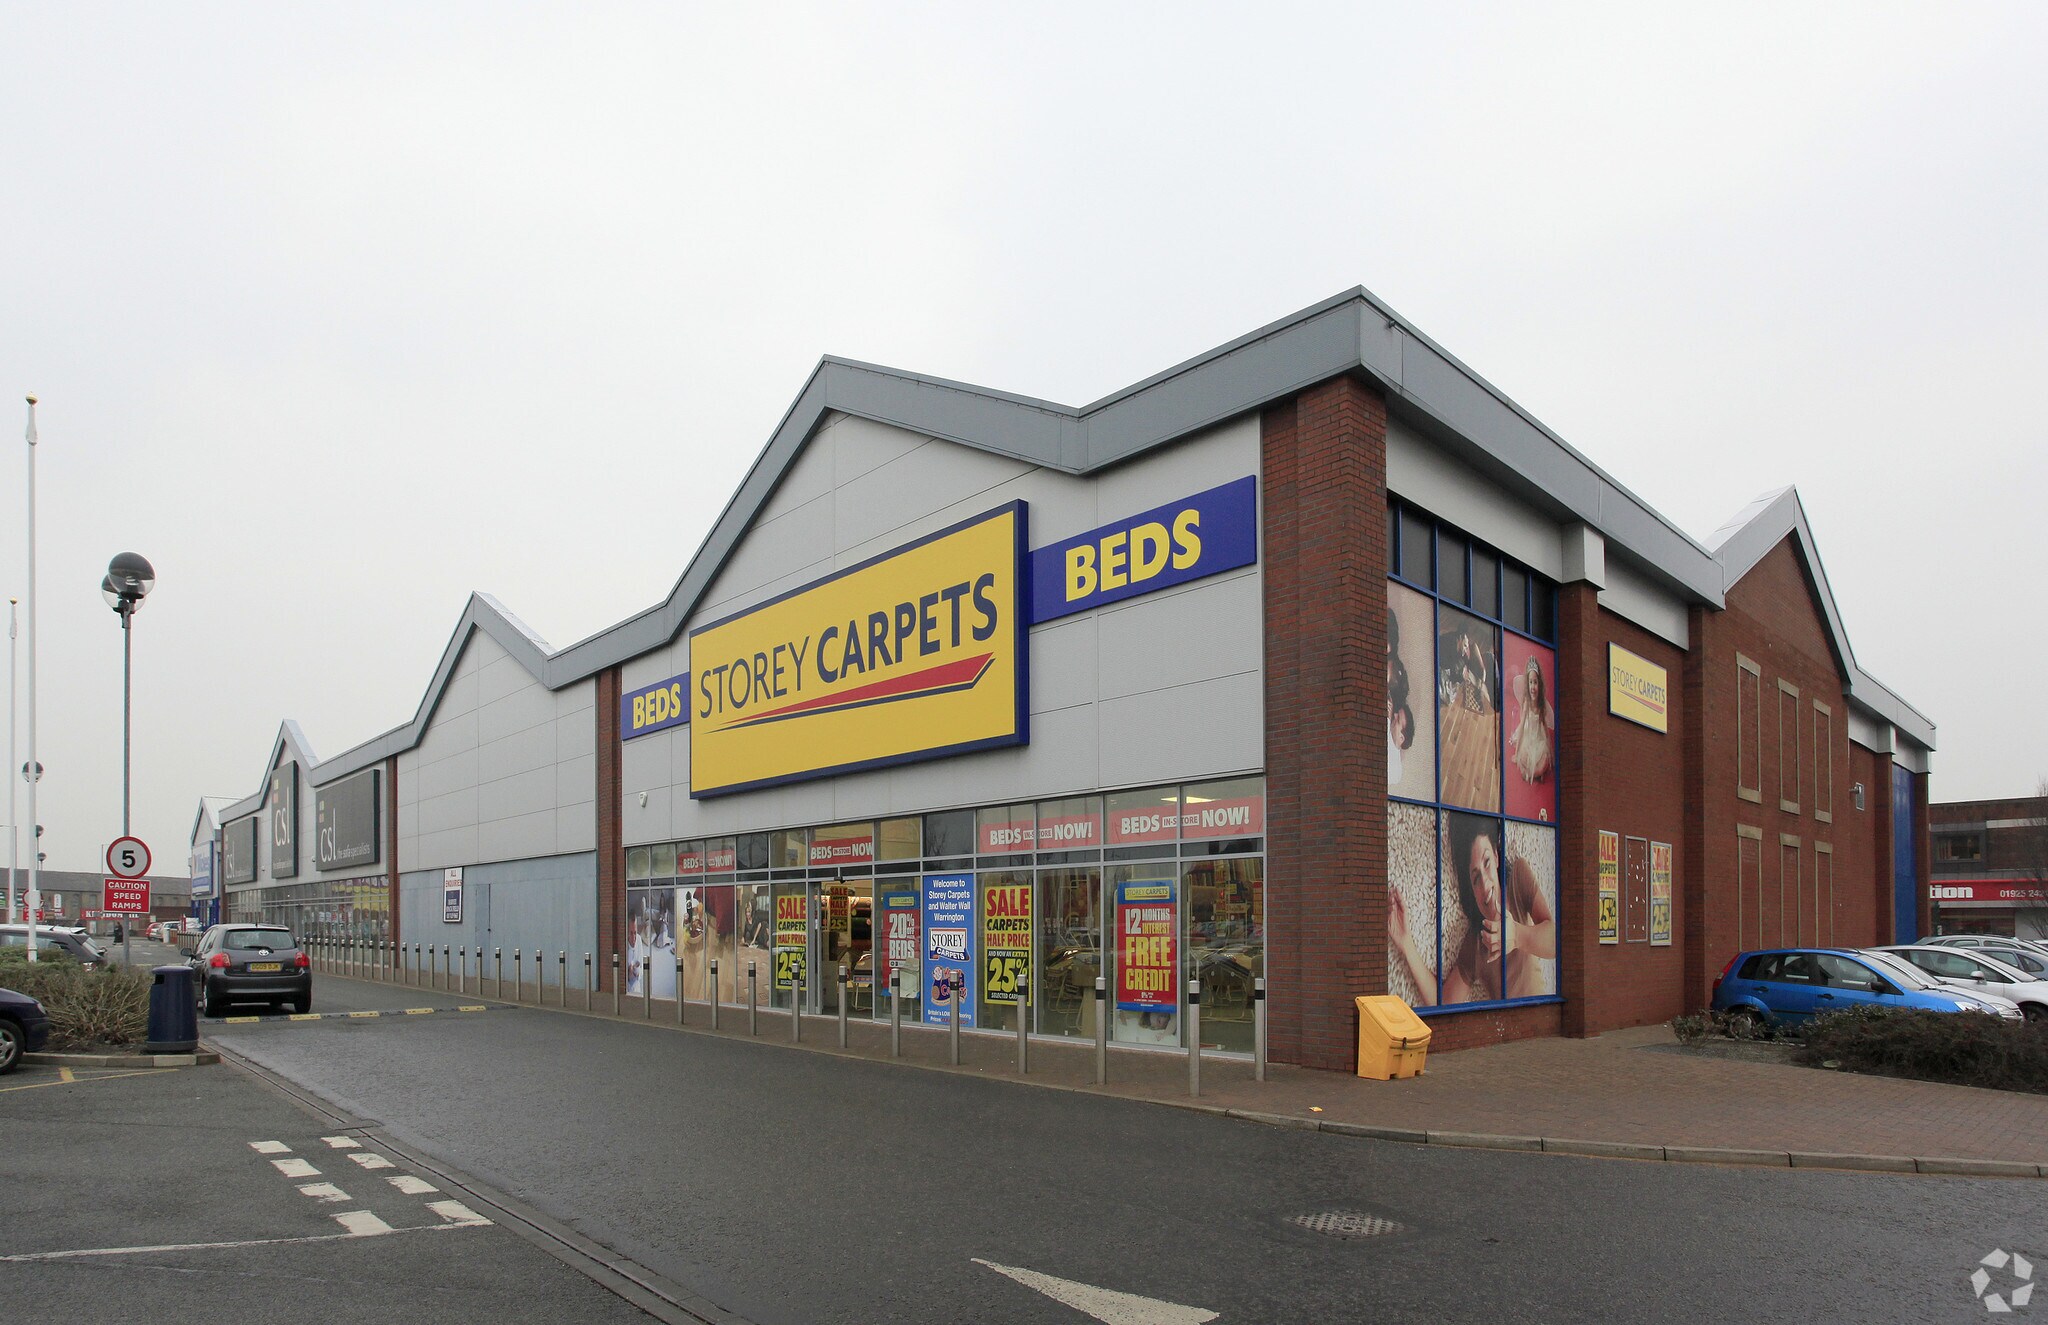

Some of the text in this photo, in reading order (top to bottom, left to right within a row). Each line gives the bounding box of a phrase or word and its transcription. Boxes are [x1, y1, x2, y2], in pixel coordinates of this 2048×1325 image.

[1065, 509, 1202, 603] BEDS
[700, 573, 998, 718] STOREY CARPETS
[1612, 666, 1666, 704] STOREY CARPETS
[632, 682, 681, 730] BEDS
[275, 787, 290, 847] csl
[1121, 806, 1249, 834] BEDS IN-STORE NOW!
[321, 808, 336, 862] csl
[990, 821, 1092, 846] BEDS IN-SORE NOW!
[811, 846, 832, 860] BEDS
[1601, 836, 1616, 861] ALE
[122, 850, 136, 868] 5
[683, 857, 699, 869] BEDS
[108, 882, 147, 890] CAUTION
[831, 887, 848, 895] SALE
[933, 879, 966, 888] Welcome to
[113, 892, 141, 900] SPEED
[929, 890, 971, 900] Storey Carpets
[986, 889, 1029, 917] SALE
[112, 902, 142, 910] RAMPS
[778, 897, 806, 920] SALE
[831, 900, 848, 909] HALF
[928, 902, 939, 910] and
[958, 901, 971, 910] Wall
[778, 921, 806, 931] CARPETS
[889, 913, 914, 939] 20%
[934, 913, 965, 923] Warrington
[986, 918, 1029, 931] CARPETS
[1125, 908, 1170, 934] 12 MONTHS
[1142, 922, 1170, 934] INTEREST
[778, 932, 806, 944] HALF PRICE
[931, 934, 963, 947] STOREY
[987, 933, 1029, 947] HALF PRICE
[889, 940, 914, 959] BEDS
[936, 948, 965, 960] CARPETS
[1125, 936, 1171, 967] FREE
[988, 958, 1028, 993] 25%
[1125, 968, 1171, 992] CREDIT
